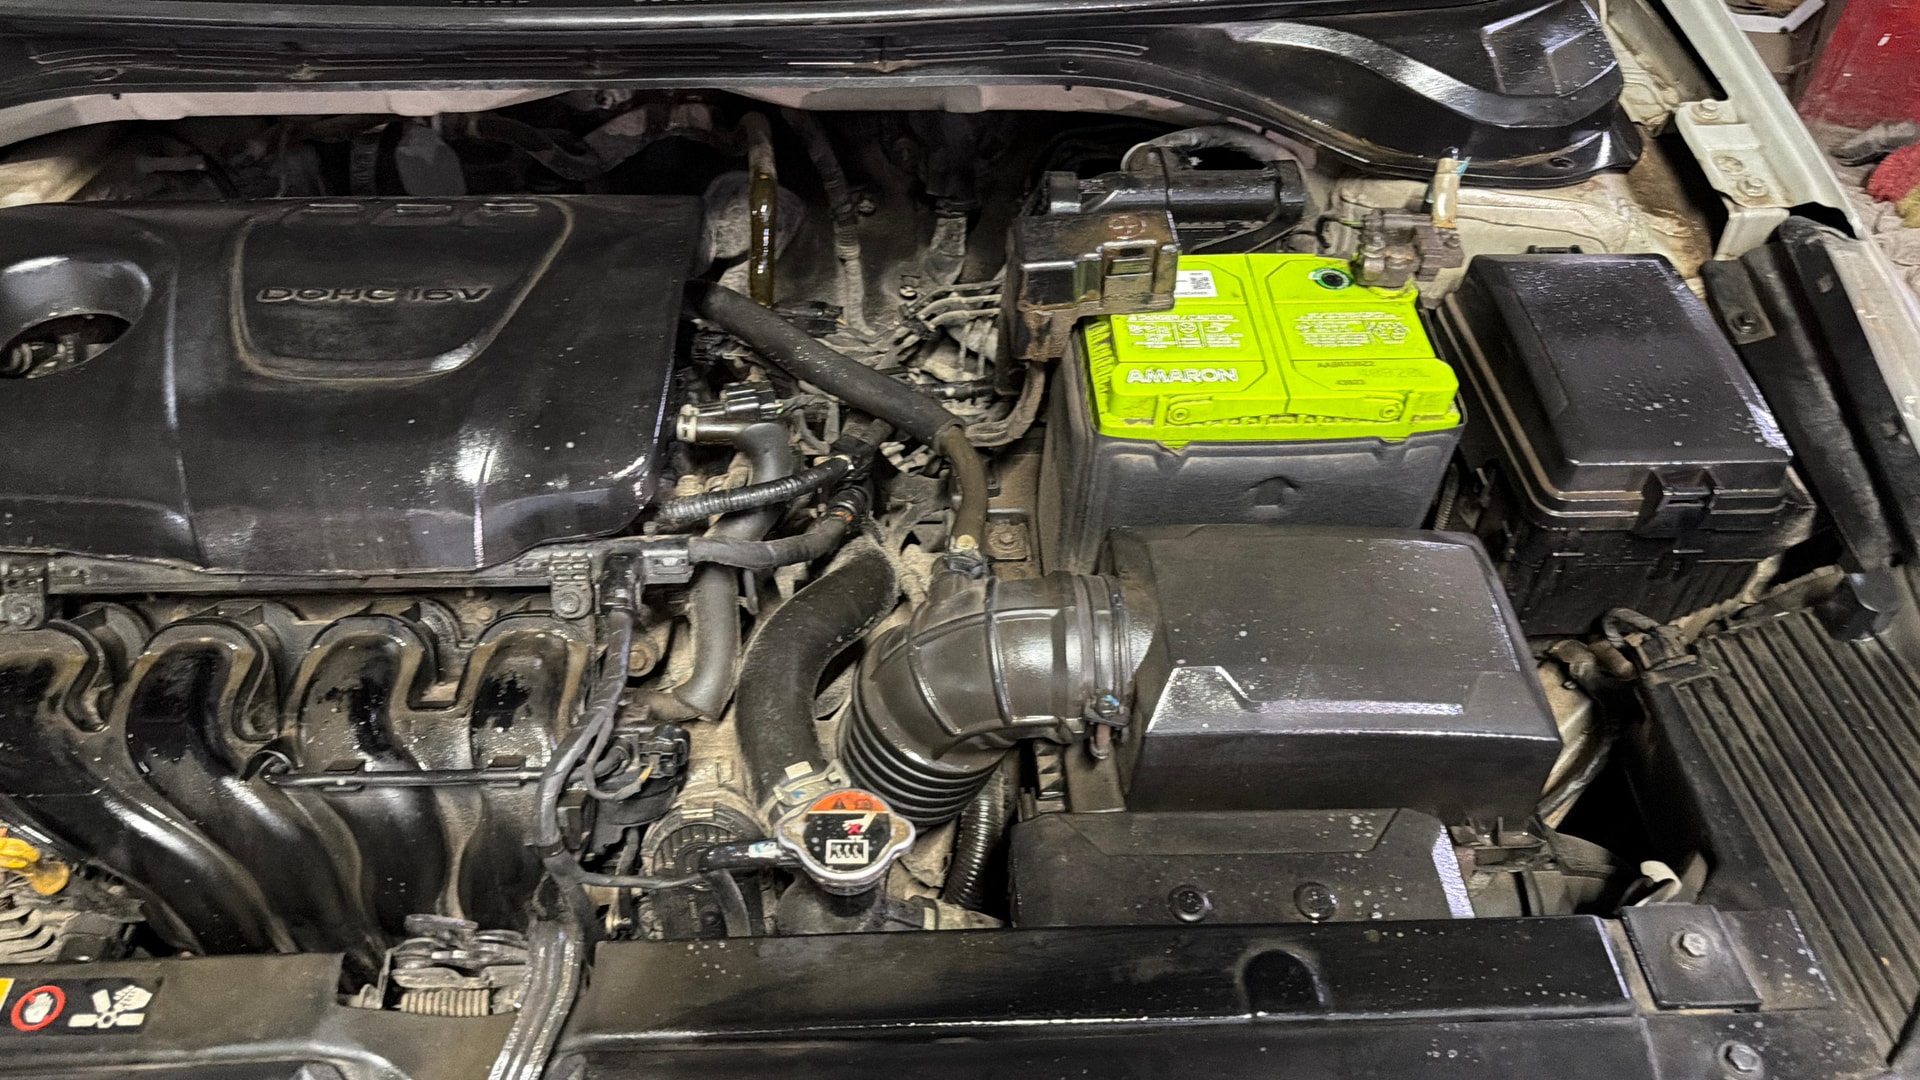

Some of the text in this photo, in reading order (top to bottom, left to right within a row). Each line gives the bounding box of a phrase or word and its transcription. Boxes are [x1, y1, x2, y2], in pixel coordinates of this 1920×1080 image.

[256, 286, 493, 302] DOHC 16V
[1126, 368, 1239, 384] AMARON
